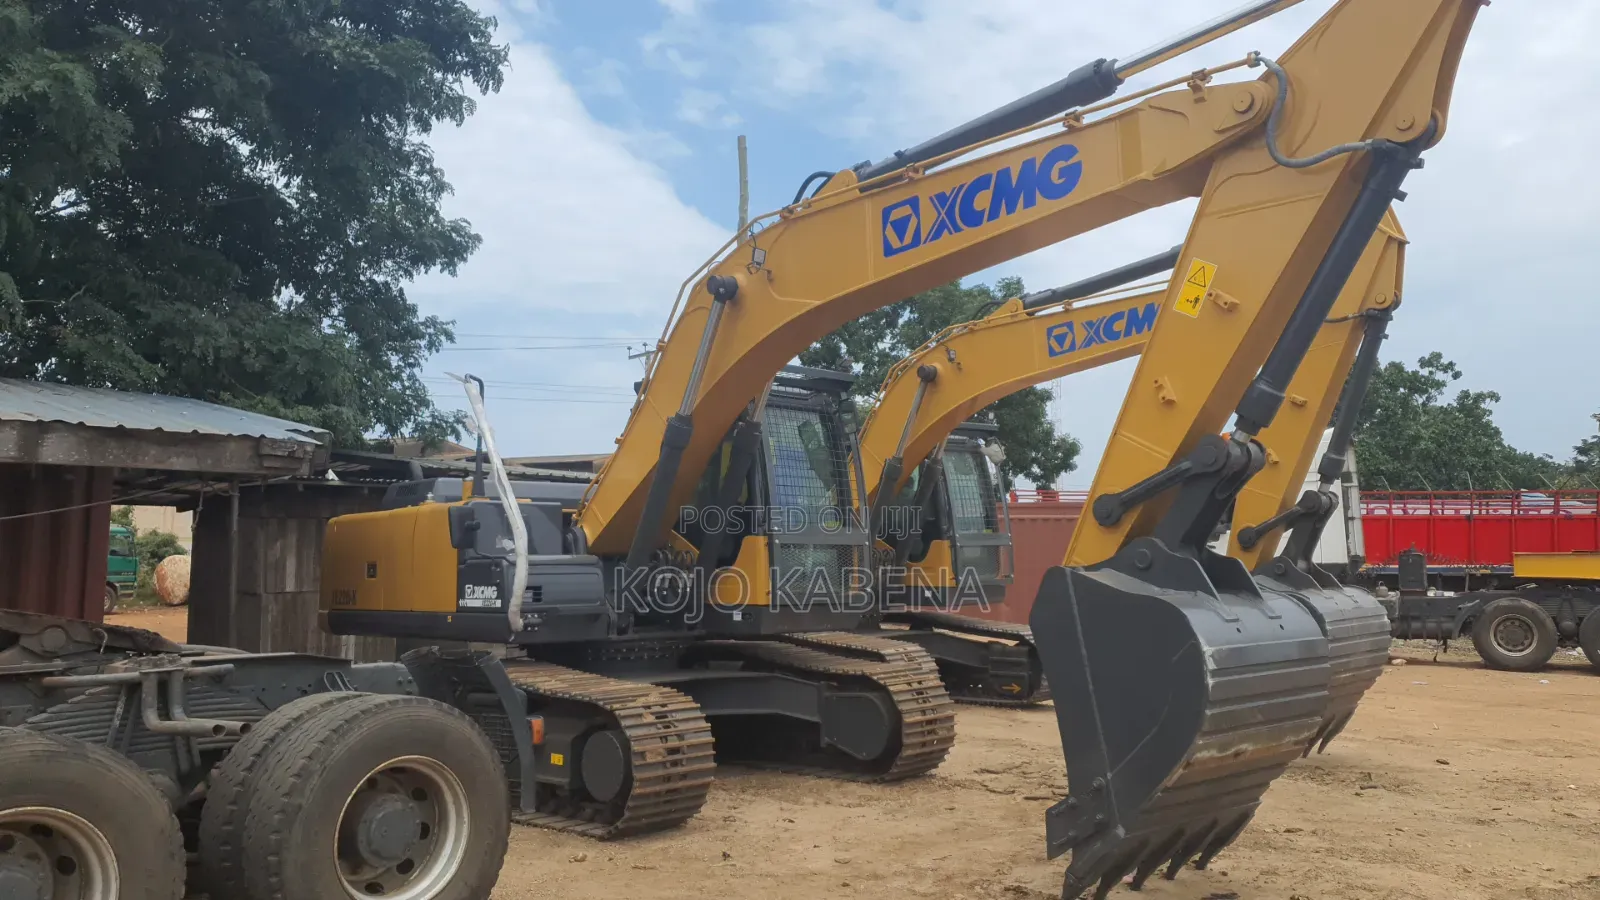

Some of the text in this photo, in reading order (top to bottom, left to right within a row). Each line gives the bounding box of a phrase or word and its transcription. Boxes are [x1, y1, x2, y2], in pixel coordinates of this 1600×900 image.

[922, 144, 1082, 244] XCMG
[1078, 302, 1160, 350] XCM
[473, 585, 498, 599] XCMG
